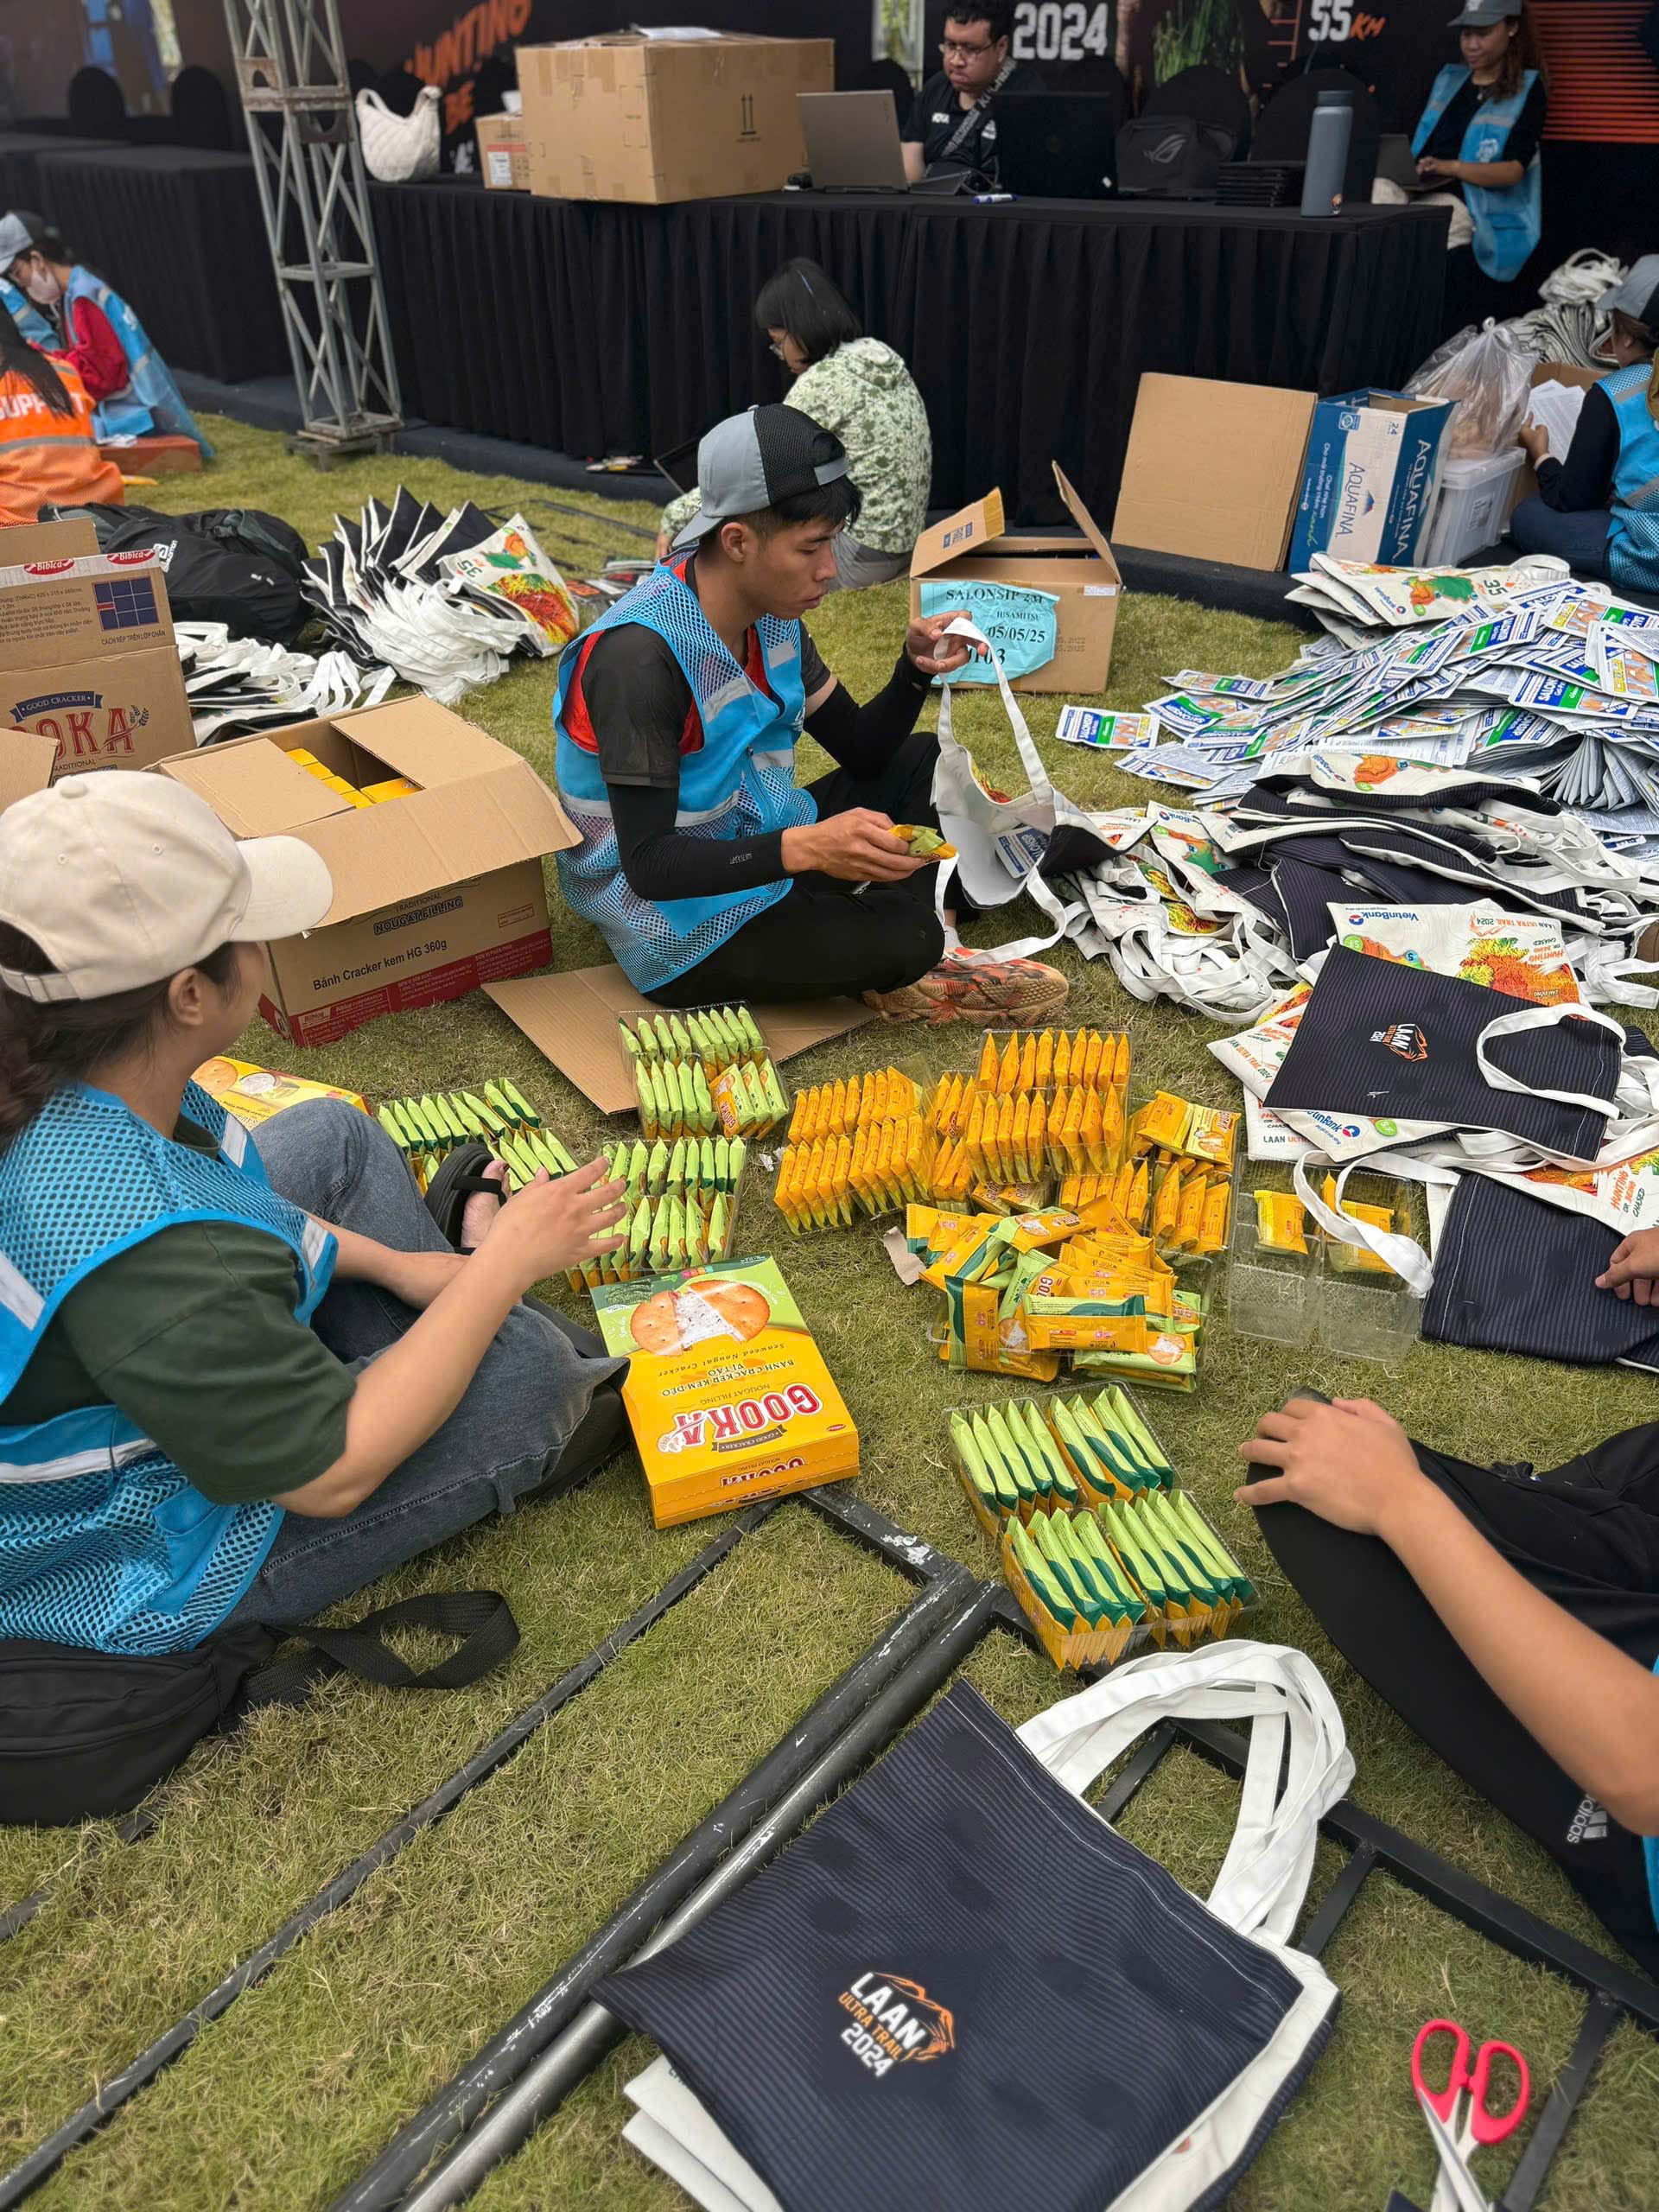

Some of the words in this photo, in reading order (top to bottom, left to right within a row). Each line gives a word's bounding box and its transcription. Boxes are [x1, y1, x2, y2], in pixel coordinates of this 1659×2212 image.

[1308, 0, 1354, 41] 55
[1013, 3, 1108, 60] 2024
[1336, 461, 1365, 537] AQUAFINA
[1392, 439, 1432, 563] AQUAFINA
[119, 550, 144, 561] Bibica
[37, 562, 62, 571] Bibica
[946, 588, 1020, 602] SALONSIP
[1484, 580, 1508, 596] 35
[988, 626, 1046, 644] 05/05/25
[26, 699, 49, 711] GOOD
[51, 694, 86, 705] CRACKER
[54, 759, 97, 772] RADITIONAL
[396, 893, 442, 912] TRADITIONAL
[373, 908, 423, 936] NOUGAT
[423, 896, 463, 921] FILLING
[1363, 911, 1419, 922] VietinBank
[1496, 918, 1516, 927] TRAIL
[1529, 949, 1565, 963] HUNTING
[313, 973, 340, 991] Bánh
[343, 962, 382, 982] Cracker
[385, 953, 405, 968] kem
[406, 948, 423, 960] HG
[424, 939, 448, 956] 360g
[1391, 1024, 1417, 1050] LAAN
[1258, 1067, 1273, 1080] 2024
[1263, 1135, 1286, 1144] LAAN
[1611, 1170, 1630, 1211] HUNTING
[1624, 1180, 1637, 1205] BEING
[1623, 1203, 1631, 1213] OR
[1632, 1187, 1645, 1218] CHASED
[741, 1343, 786, 1357] Seaweed
[701, 1352, 740, 1367] Nougat
[657, 1362, 698, 1378] Cracker
[713, 1368, 764, 1384] CRACKER
[686, 1378, 710, 1389] KEM
[732, 1383, 771, 1398] NOUGAT
[700, 1391, 732, 1405] FILLING
[675, 1383, 822, 1446] GOOKA
[850, 1971, 926, 2050] LAAN
[837, 1990, 874, 2028] ULTRA
[871, 2024, 904, 2061] TRAIL
[841, 2022, 895, 2077] 2024
